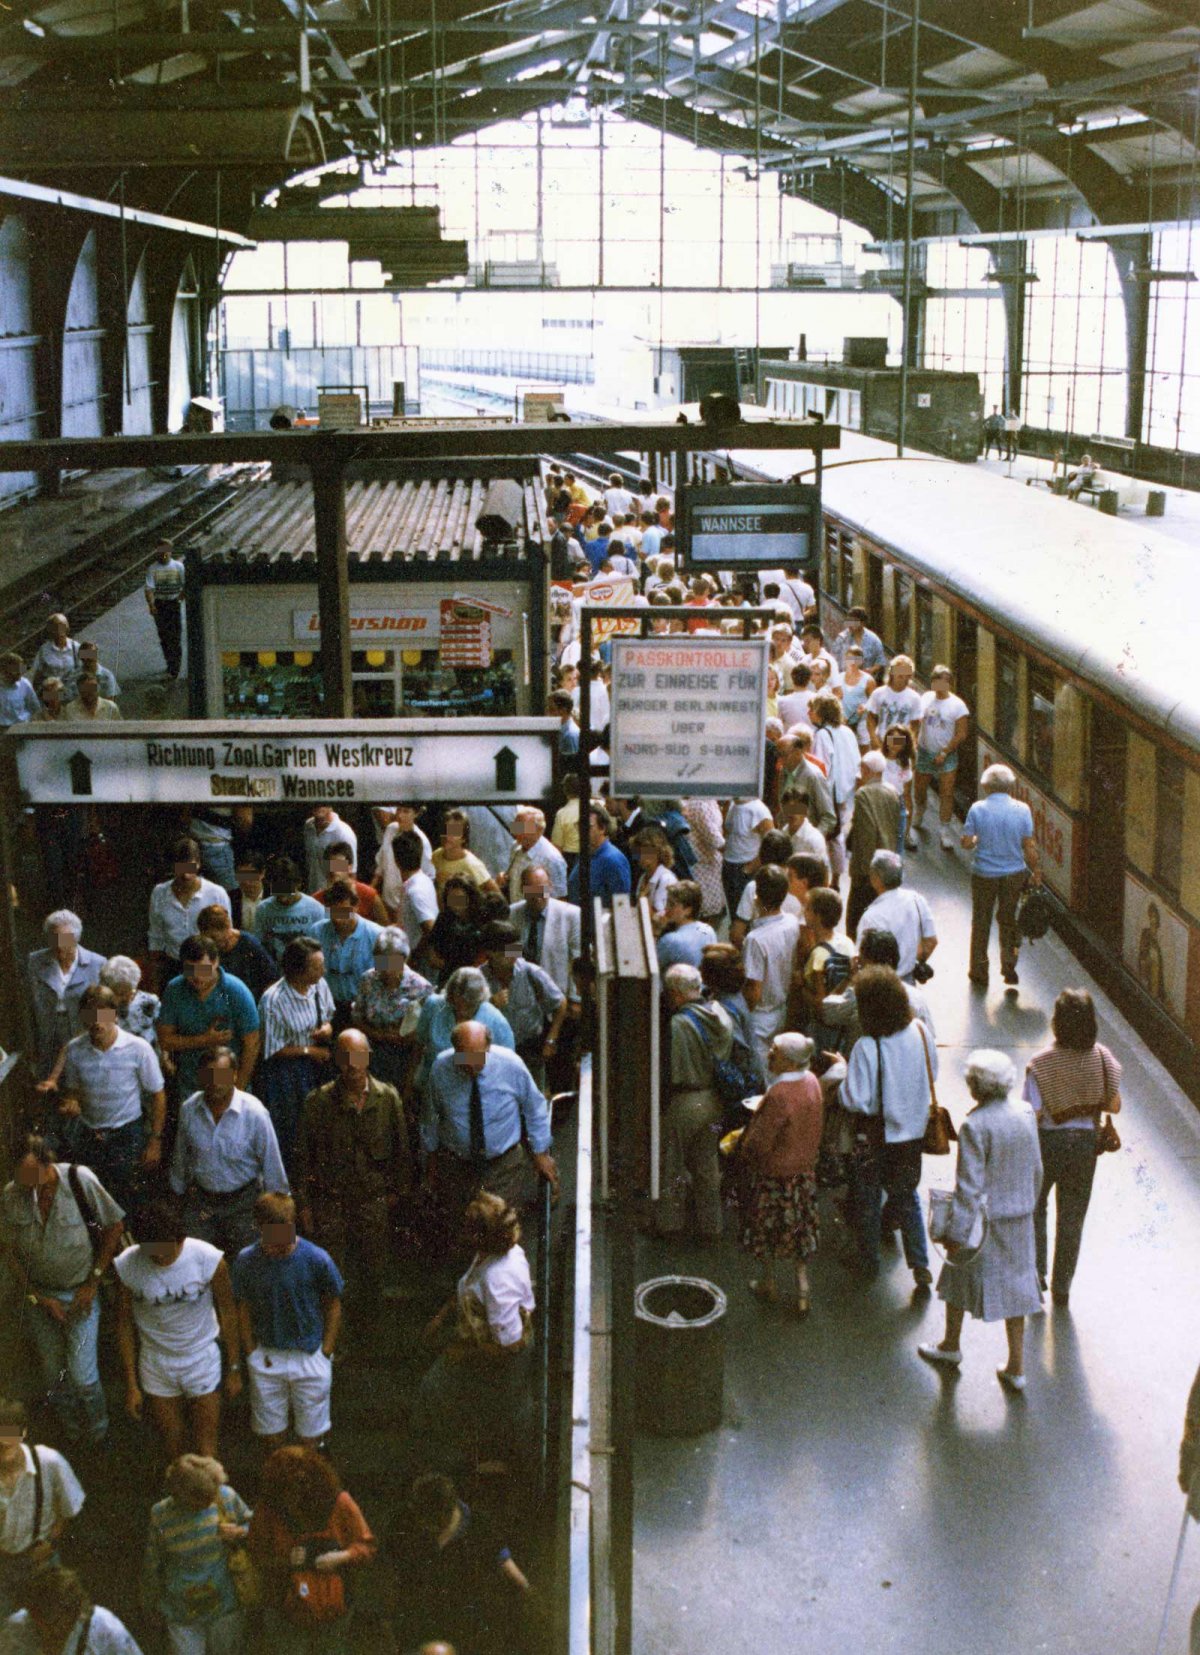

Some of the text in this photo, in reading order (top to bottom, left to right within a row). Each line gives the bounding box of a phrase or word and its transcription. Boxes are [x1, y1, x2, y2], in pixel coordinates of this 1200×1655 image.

[701, 516, 762, 532] WANNSEE
[625, 650, 751, 668] PASSKONTROLLE
[617, 669, 758, 690] ZUR EINREISE FÜR
[146, 742, 216, 770] Richtung
[324, 742, 414, 767] Westkreuz
[281, 774, 355, 798] Wannsee
